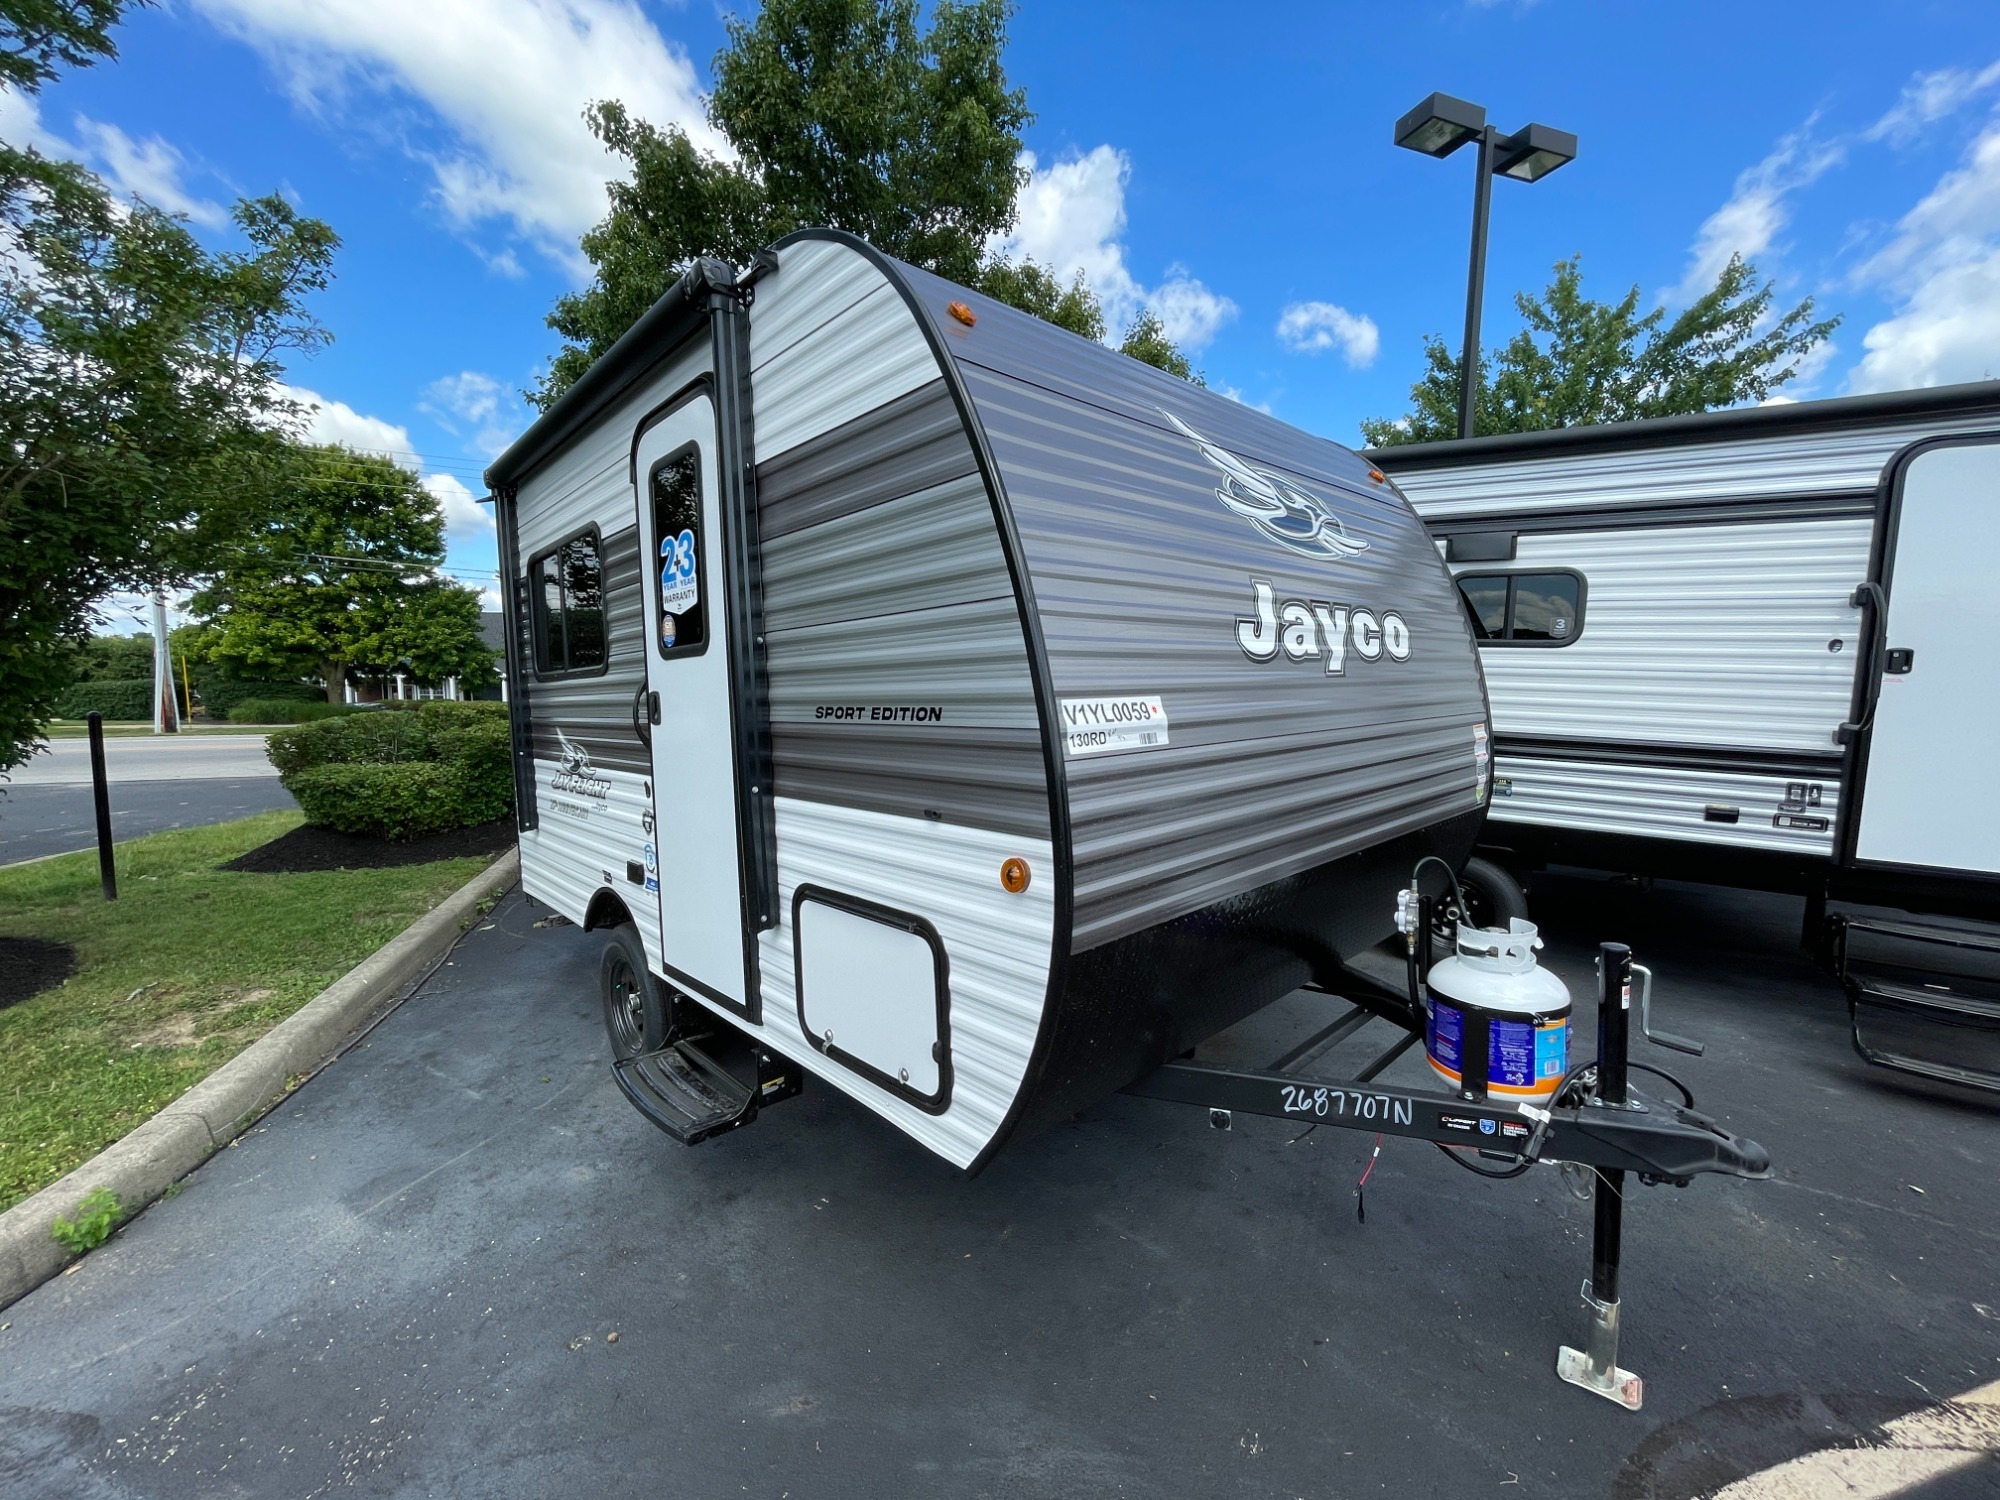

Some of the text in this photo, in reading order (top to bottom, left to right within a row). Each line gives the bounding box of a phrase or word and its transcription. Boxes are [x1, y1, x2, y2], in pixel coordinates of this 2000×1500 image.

[664, 577, 695, 591] YEAR YEAR
[664, 589, 695, 604] WARRANTY
[1236, 579, 1410, 676] Jayco
[1555, 618, 1566, 629] 3
[815, 706, 942, 721] SPORT EDITION
[1064, 702, 1151, 725] V1YL0059
[1070, 732, 1106, 747] 130RD
[552, 770, 611, 799] JAY FLIGHT
[1281, 1086, 1412, 1125] 2687707N
